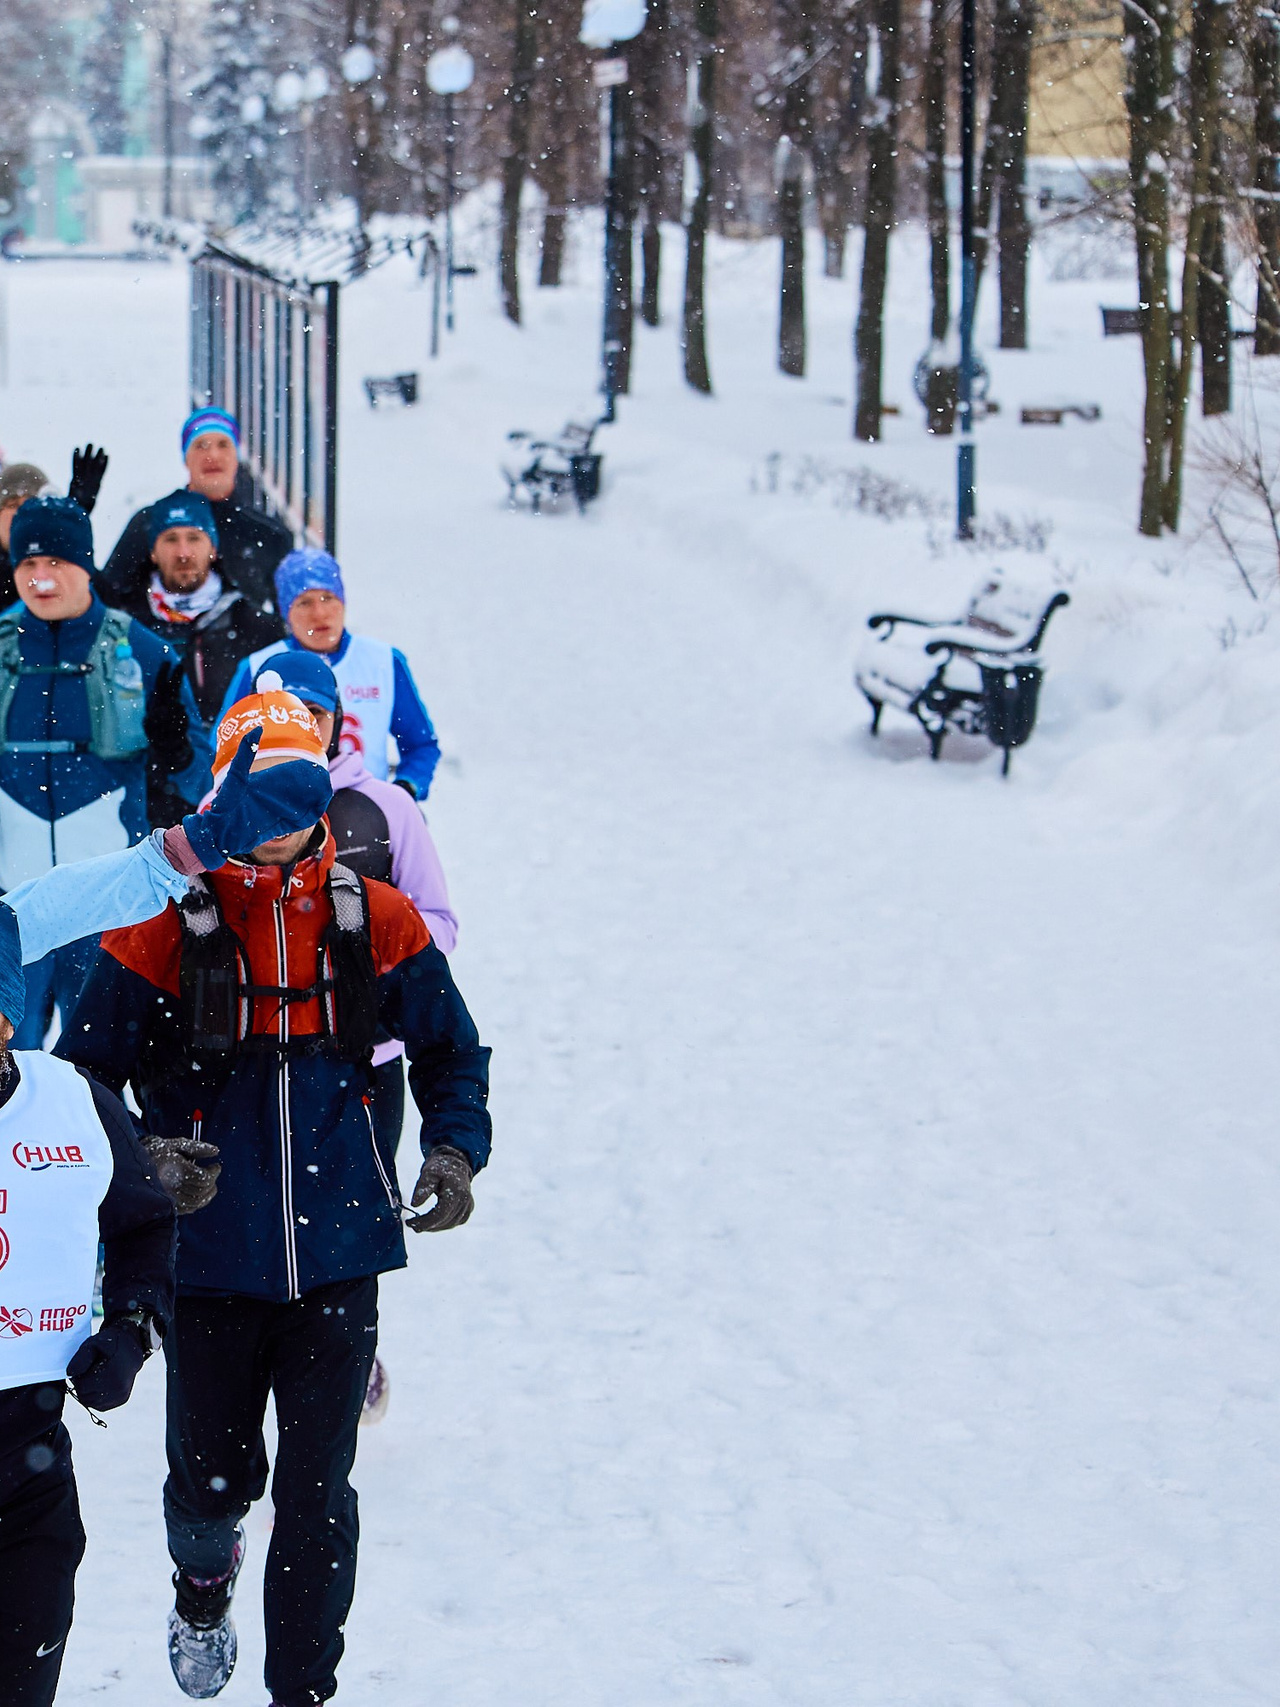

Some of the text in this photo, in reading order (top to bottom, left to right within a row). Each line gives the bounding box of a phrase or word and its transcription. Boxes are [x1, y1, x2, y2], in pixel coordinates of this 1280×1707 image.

[23, 1145, 84, 1163] НЦВ
[40, 1304, 87, 1319] ППОО
[39, 1318, 74, 1332] НЦВ
